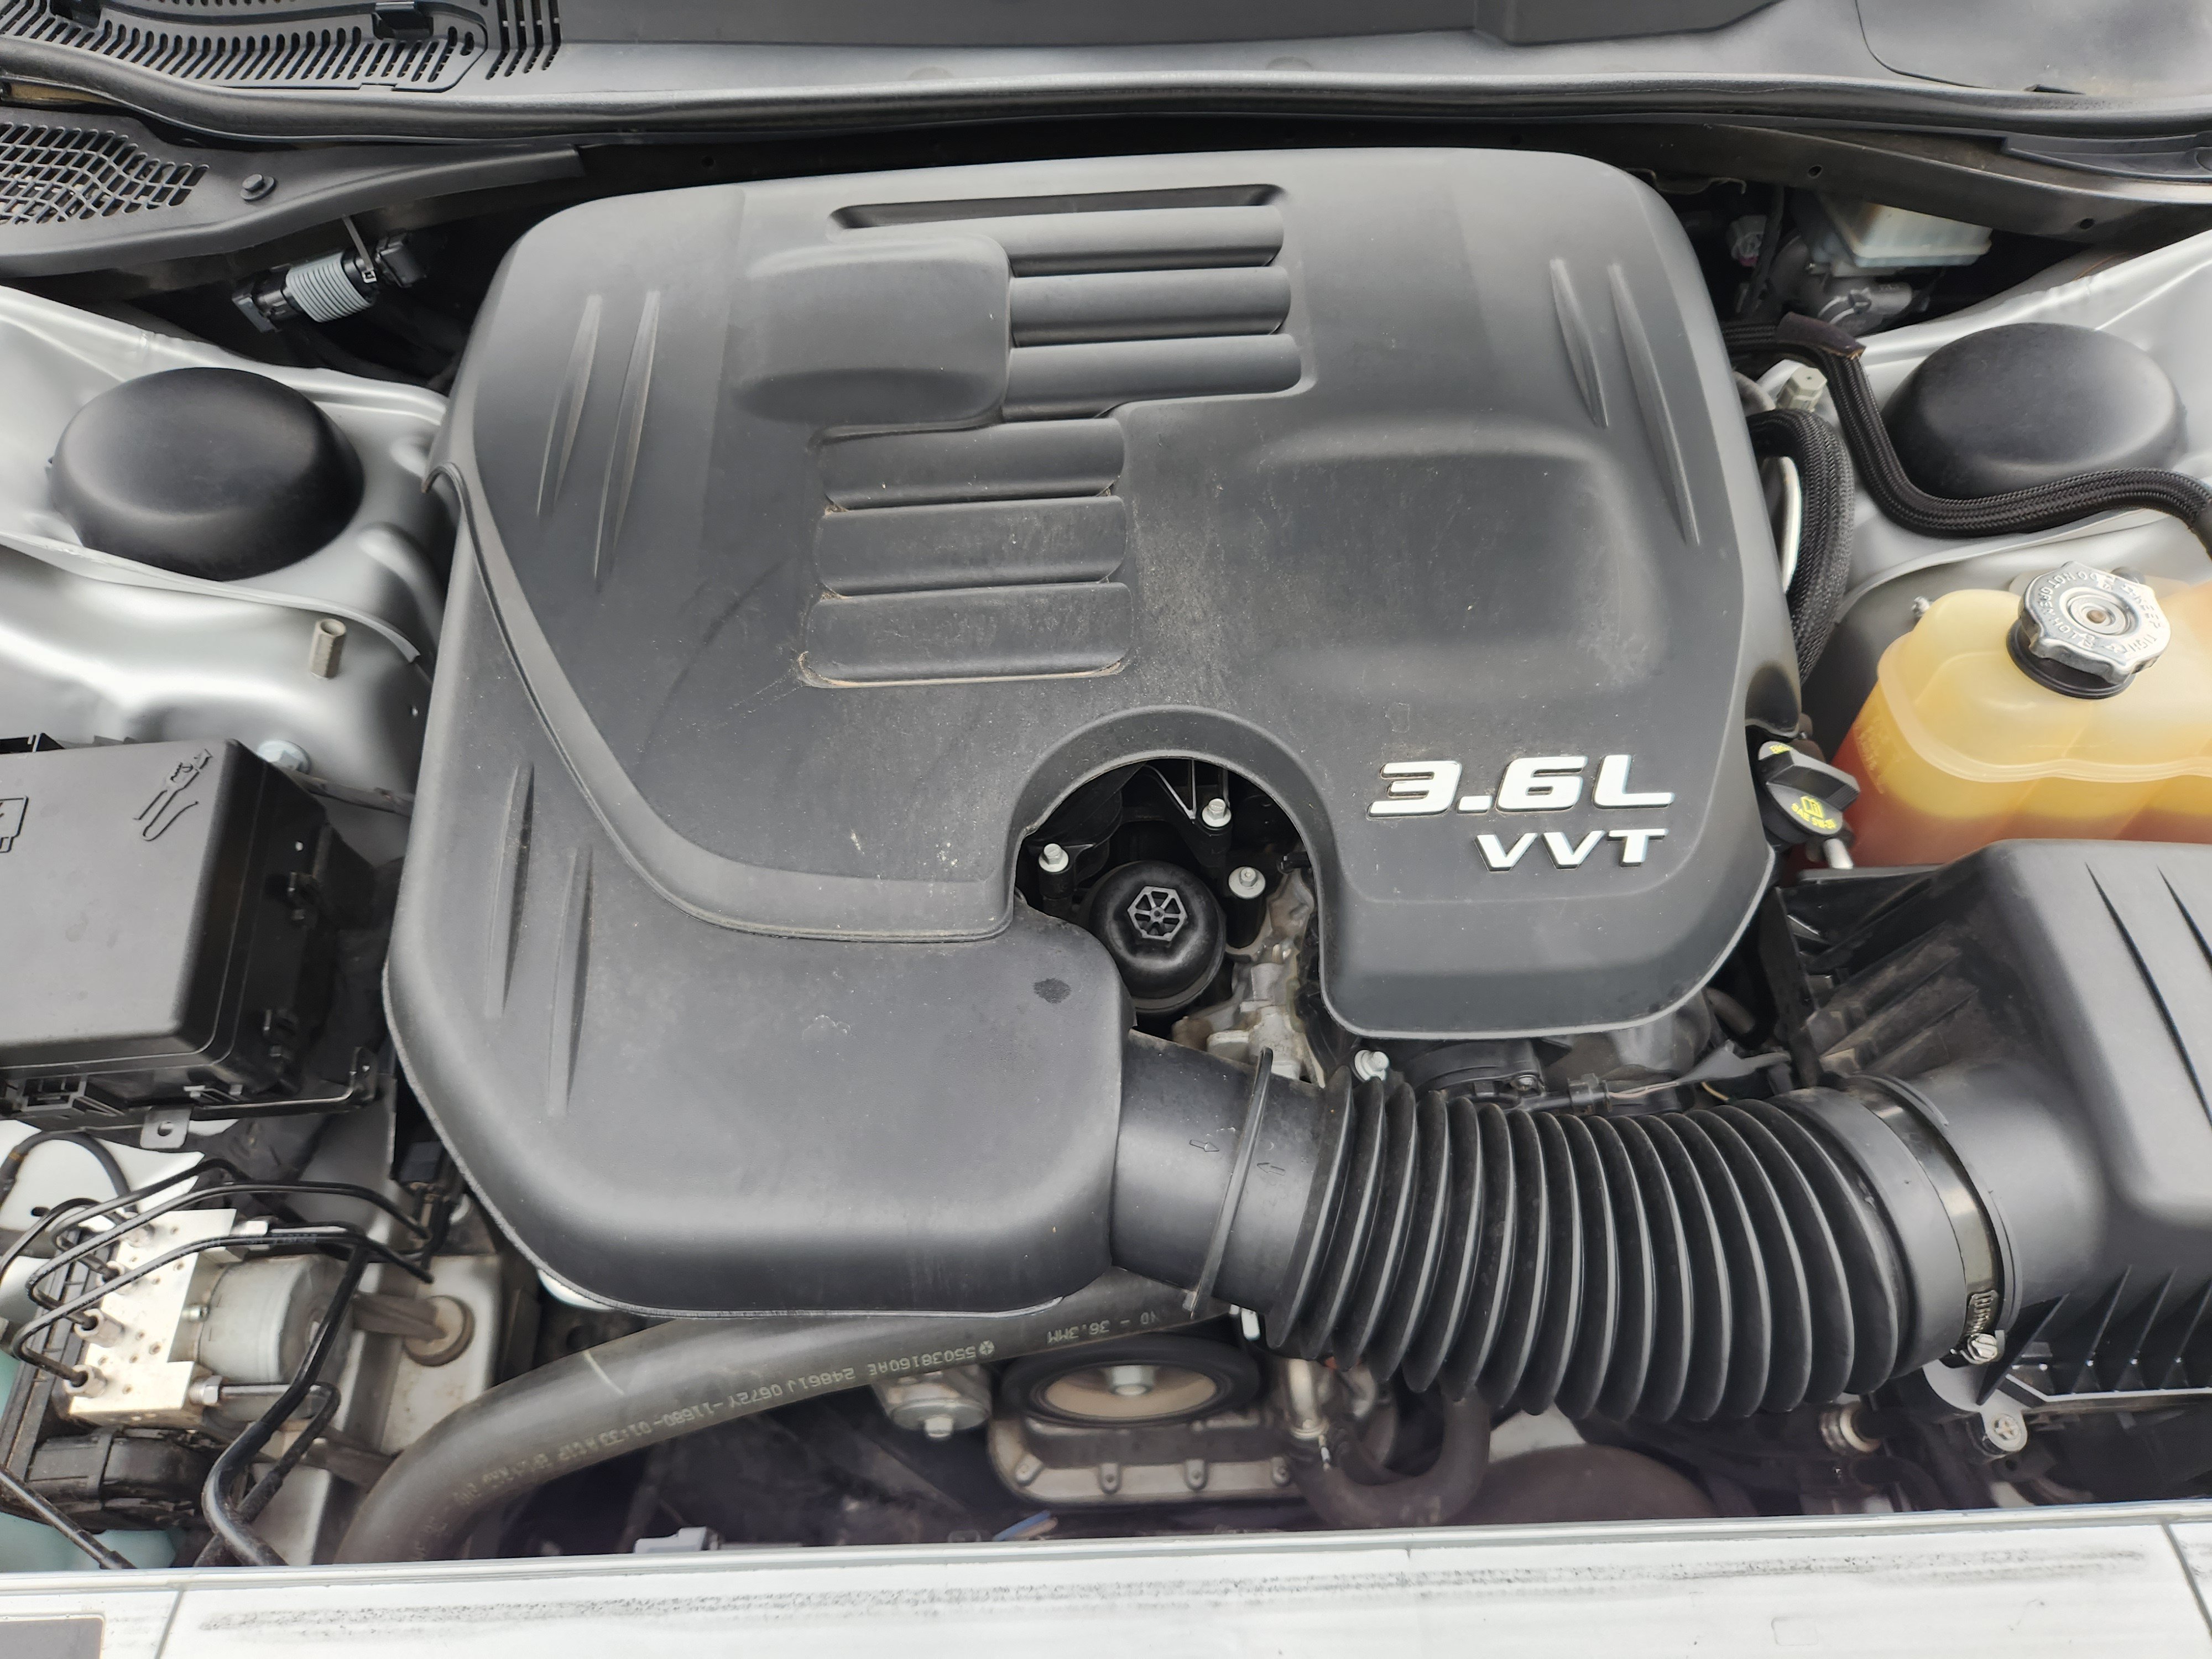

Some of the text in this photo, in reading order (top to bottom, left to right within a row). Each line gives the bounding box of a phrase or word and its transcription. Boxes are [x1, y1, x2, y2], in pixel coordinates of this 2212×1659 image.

[2048, 571, 2075, 588] NOT
[2052, 617, 2078, 639] HOT
[1366, 754, 1675, 819] 3.6L
[1791, 803, 1810, 822] SAE
[1474, 828, 1669, 872] VVT
[1047, 1319, 1110, 1344] 36.3MM
[867, 1346, 976, 1375] 55038160AE
